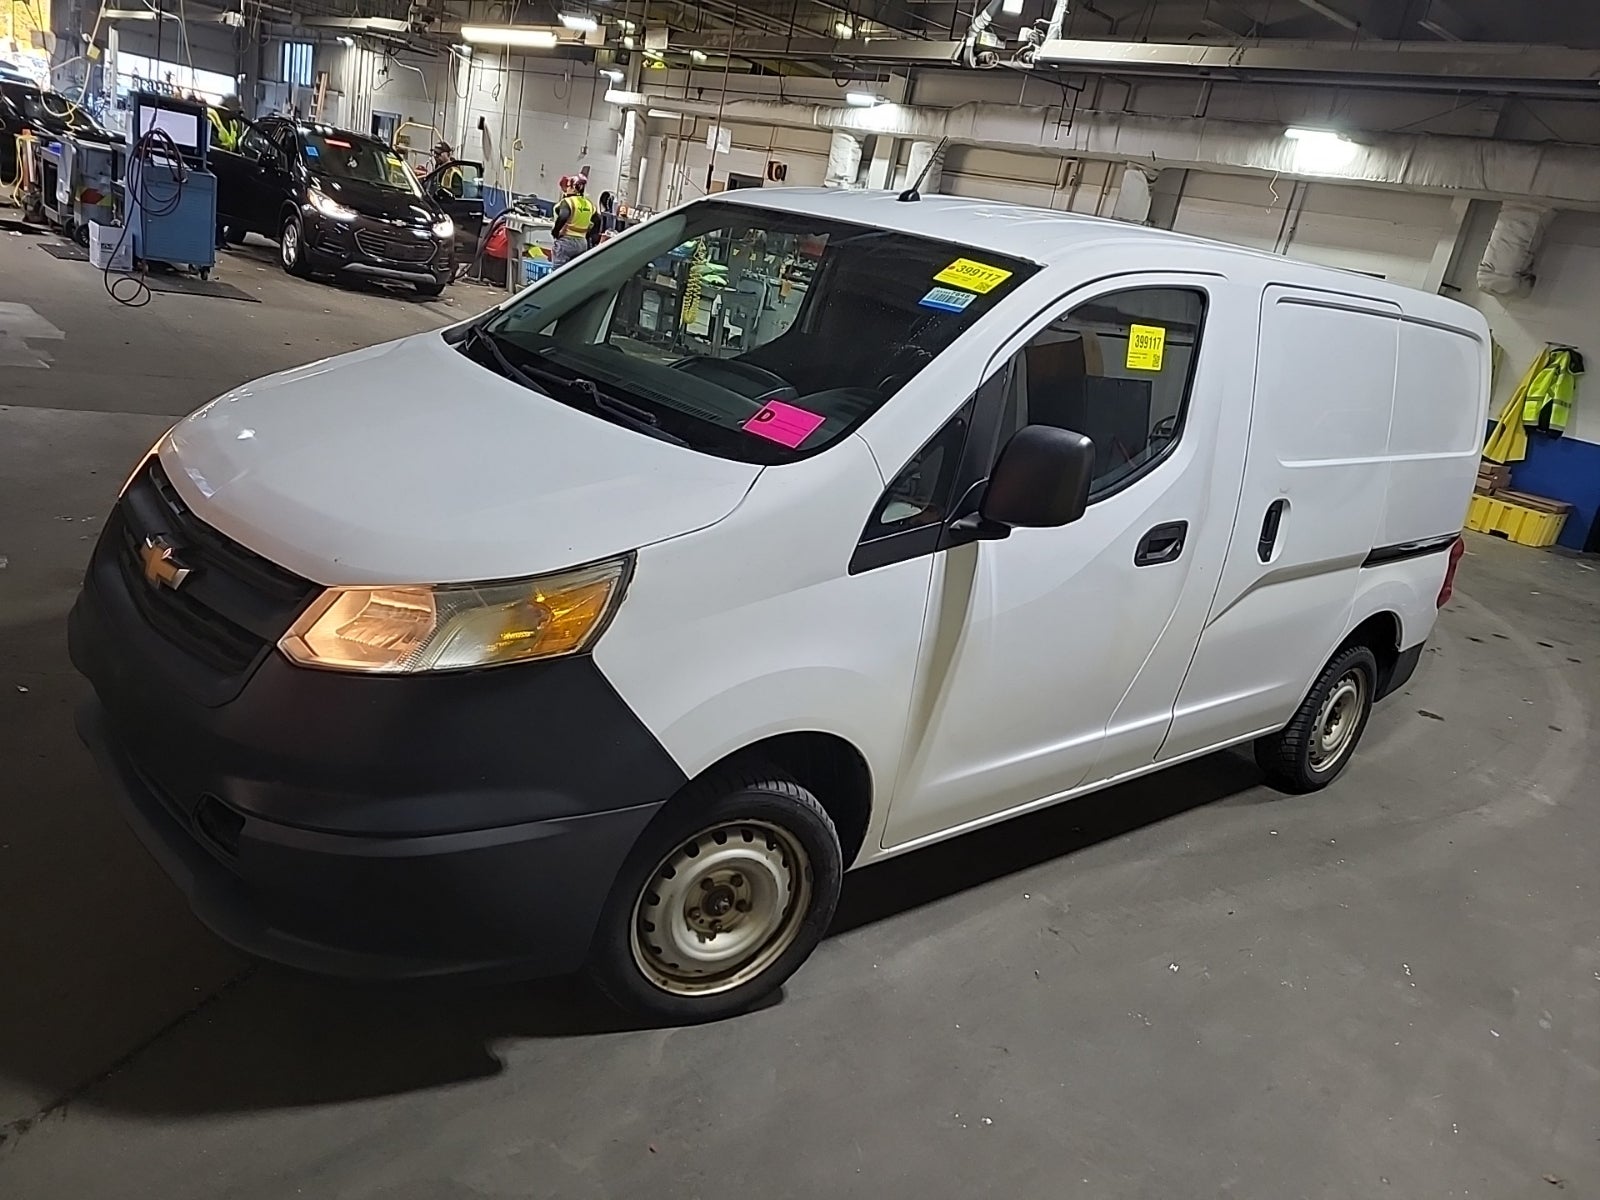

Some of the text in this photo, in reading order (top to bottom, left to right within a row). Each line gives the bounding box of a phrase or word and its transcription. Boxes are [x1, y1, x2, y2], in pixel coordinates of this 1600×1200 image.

[955, 265, 1002, 282] 399117
[1134, 334, 1162, 350] 399117
[754, 408, 776, 423] D
